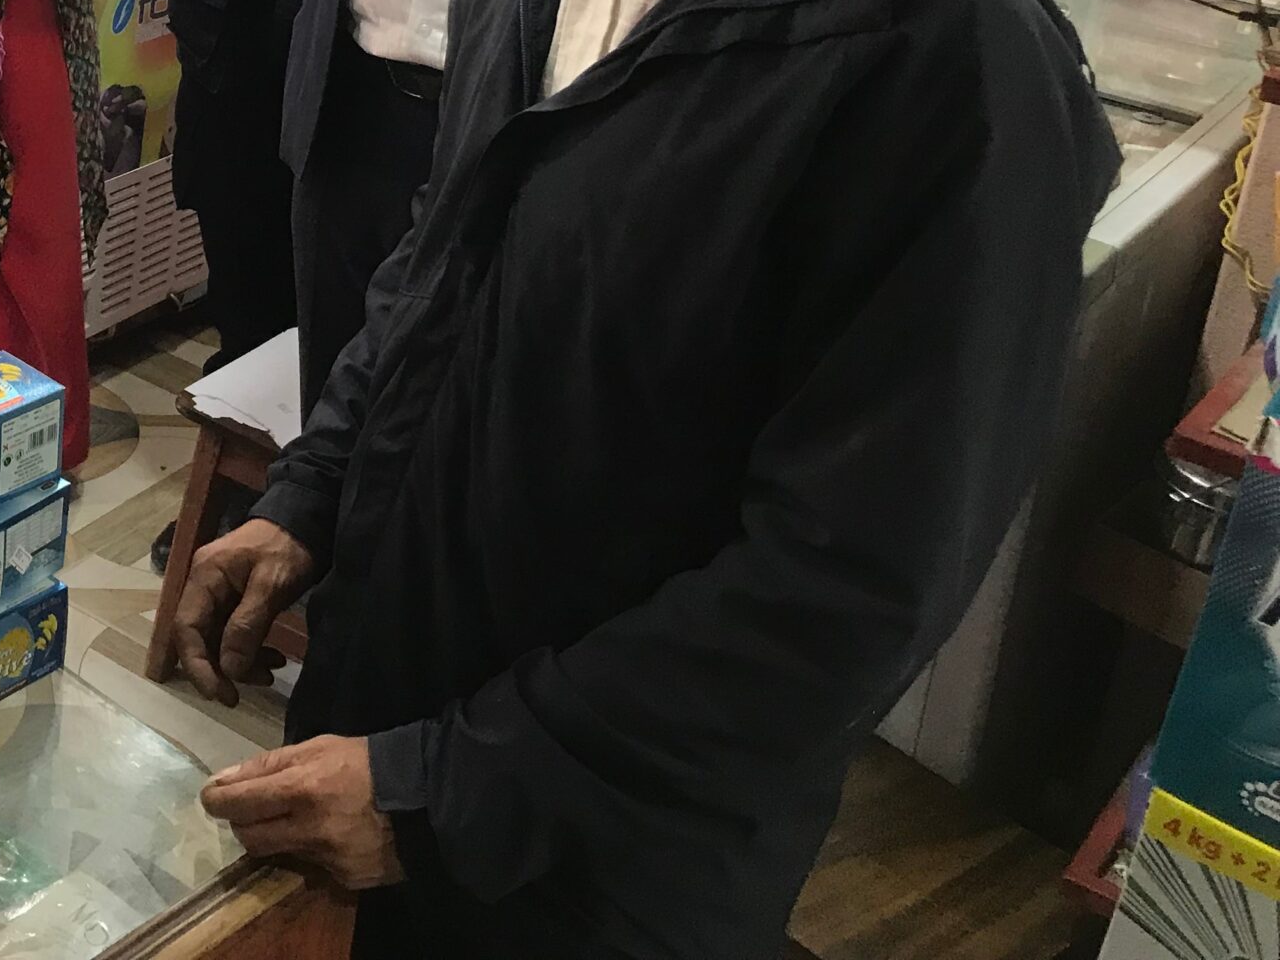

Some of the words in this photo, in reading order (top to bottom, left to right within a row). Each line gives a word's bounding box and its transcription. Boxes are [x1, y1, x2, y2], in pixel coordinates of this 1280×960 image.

[1163, 817, 1182, 838] 4
[1186, 826, 1222, 860] kg
[1230, 851, 1246, 867] +
[1250, 860, 1272, 884] 2
